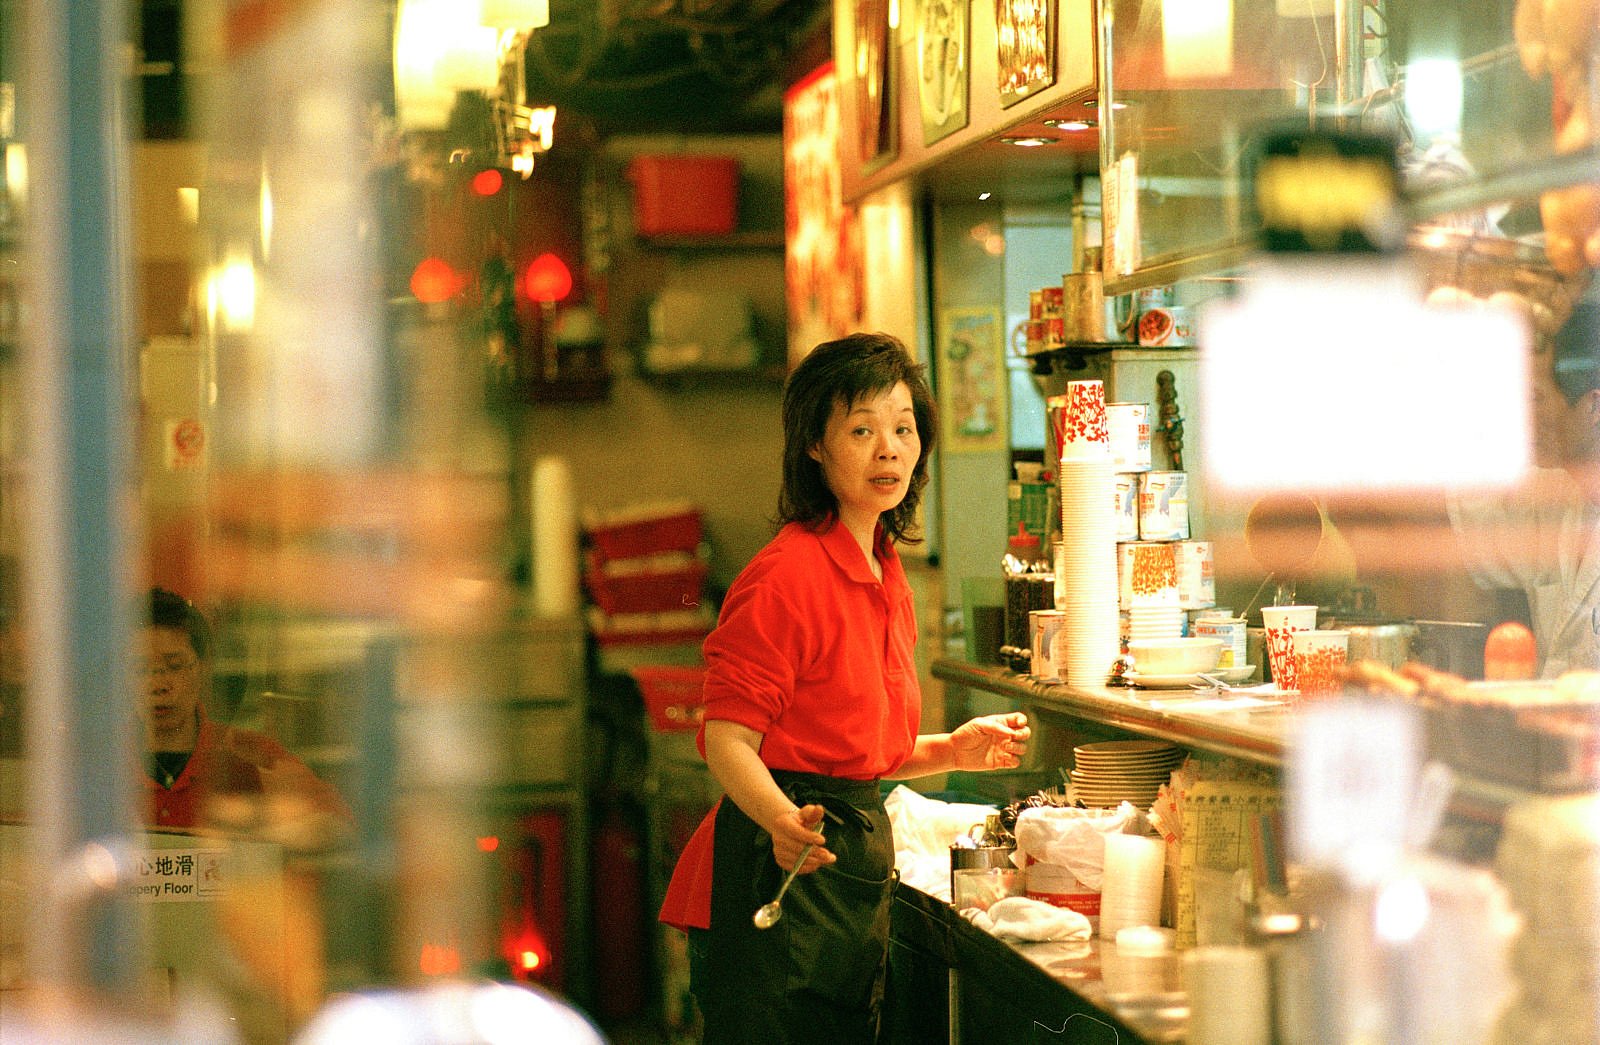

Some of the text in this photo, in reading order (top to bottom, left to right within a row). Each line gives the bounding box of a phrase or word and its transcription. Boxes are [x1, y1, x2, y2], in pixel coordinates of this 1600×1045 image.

[136, 855, 194, 876] 心地滑
[128, 882, 194, 897] ppery Floor
